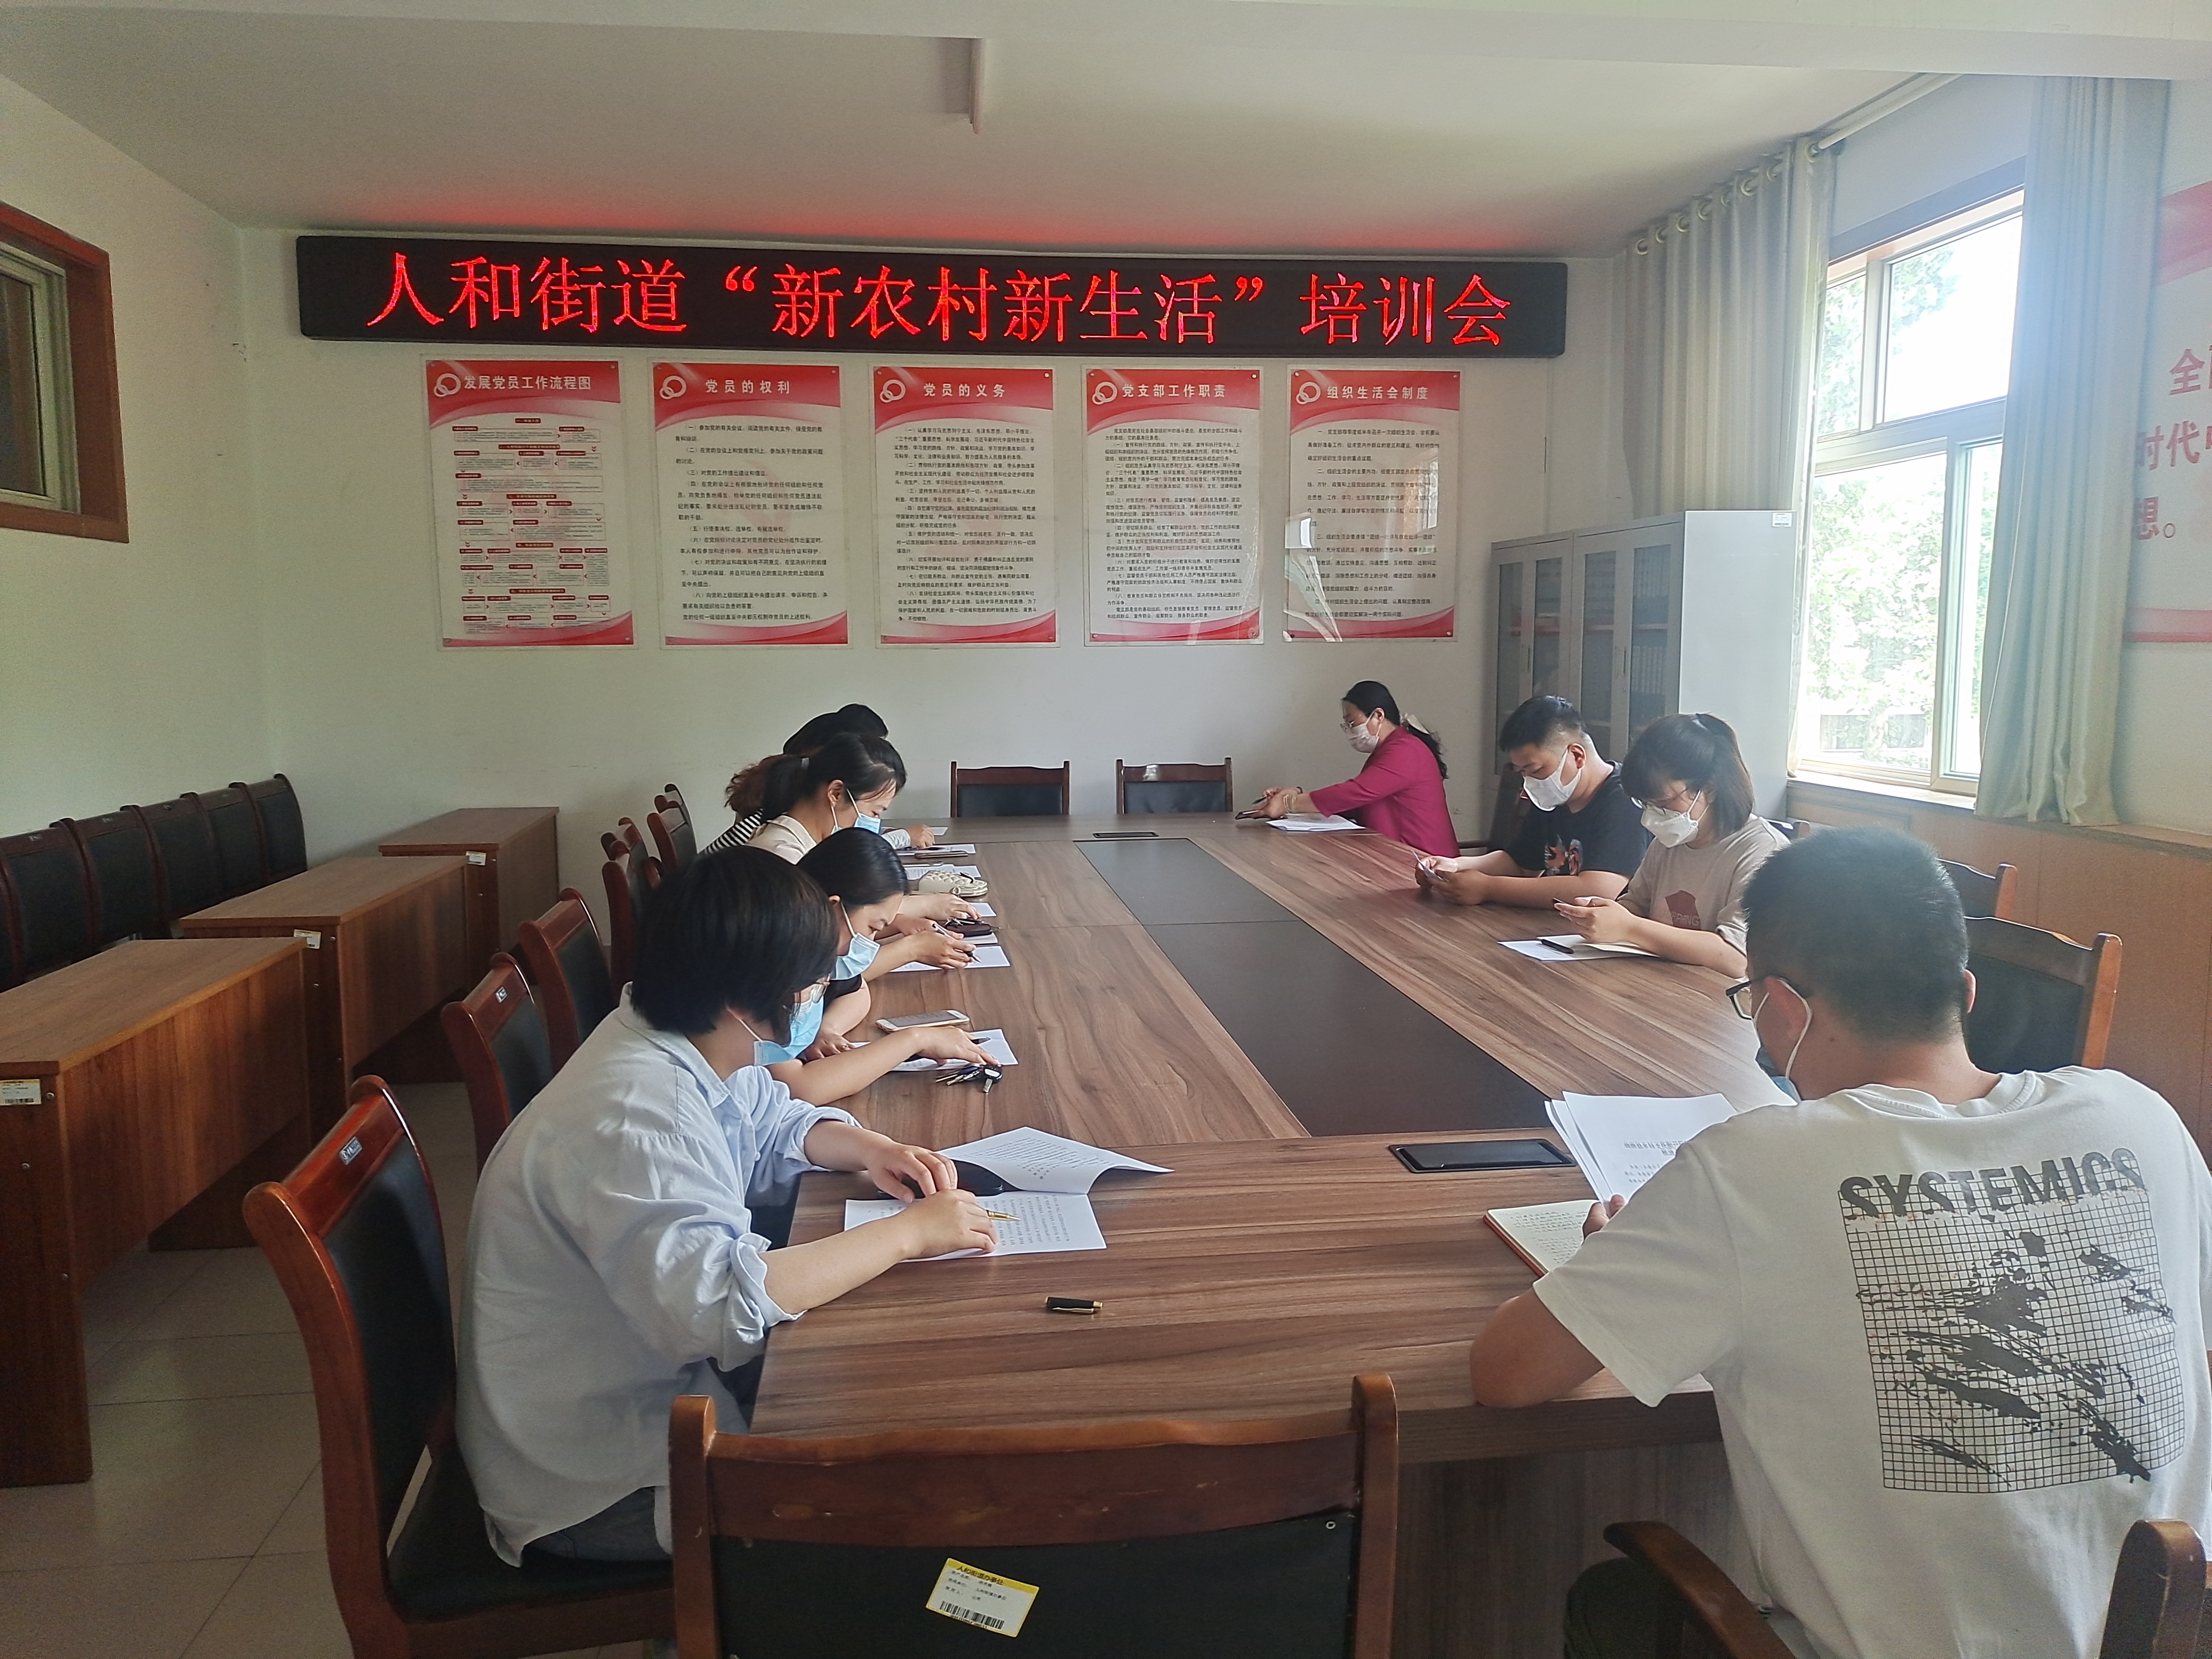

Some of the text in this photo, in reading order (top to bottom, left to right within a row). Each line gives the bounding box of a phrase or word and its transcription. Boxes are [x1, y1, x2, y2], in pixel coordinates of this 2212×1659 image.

[2168, 344, 2212, 396] 全
[464, 375, 591, 390] 发展党员工作流程图
[705, 379, 790, 394] 党员的权利
[924, 383, 1005, 398] 党员的义务
[1122, 383, 1226, 398] 党支部工作职责
[1327, 385, 1428, 400] 组织生活会制度
[2136, 420, 2212, 470] 时代
[1839, 1147, 2147, 1220] SYSTEMICS
